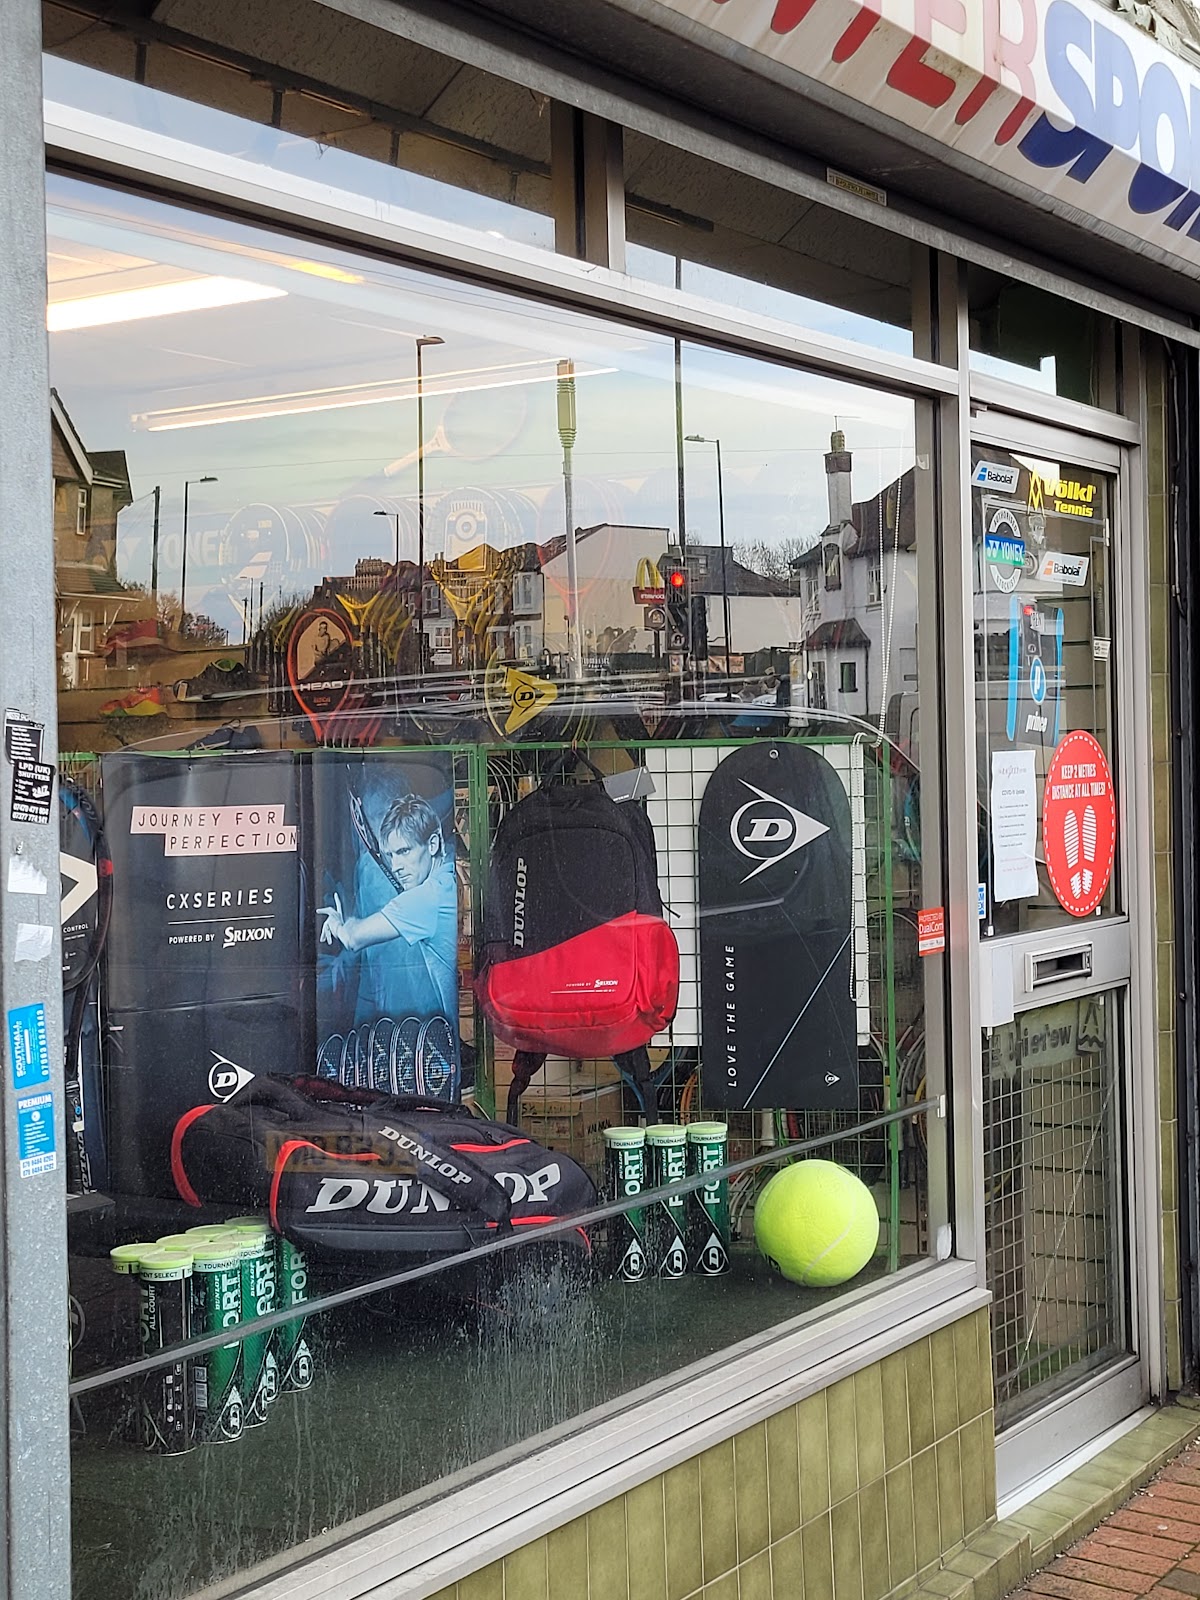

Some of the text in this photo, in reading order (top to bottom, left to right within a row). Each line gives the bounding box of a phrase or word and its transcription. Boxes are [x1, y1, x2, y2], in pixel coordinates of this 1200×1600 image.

[987, 471, 1014, 485] Babolat
[1044, 478, 1094, 502] Völkl
[1054, 500, 1094, 517] Tennis
[1001, 541, 1024, 563] YONEX
[1054, 562, 1082, 577] Babolat
[300, 681, 343, 691] HEAD
[518, 691, 534, 701] D
[1025, 711, 1048, 733] prince
[1062, 763, 1096, 779] KEEP 2 METRES
[1052, 784, 1074, 800] DISTANCE
[1075, 784, 1081, 798] AT
[1082, 783, 1090, 797] ALL
[138, 811, 276, 827] JOURNEY FOR
[743, 819, 793, 841] D
[171, 832, 296, 849] PERFECTION
[166, 888, 273, 909] CXSERIES
[514, 858, 527, 949] DUNLOP
[63, 923, 89, 933] CONTROL
[169, 935, 202, 944] POWERED
[223, 926, 275, 948] SRIXON
[725, 945, 737, 1088] LOVE THE GAME
[214, 1071, 237, 1088] D
[18, 1094, 52, 1109] PREMIUM
[378, 1126, 472, 1185] DUNLOP
[305, 1163, 561, 1214] DUNOP
[154, 1271, 178, 1279] SELECT
